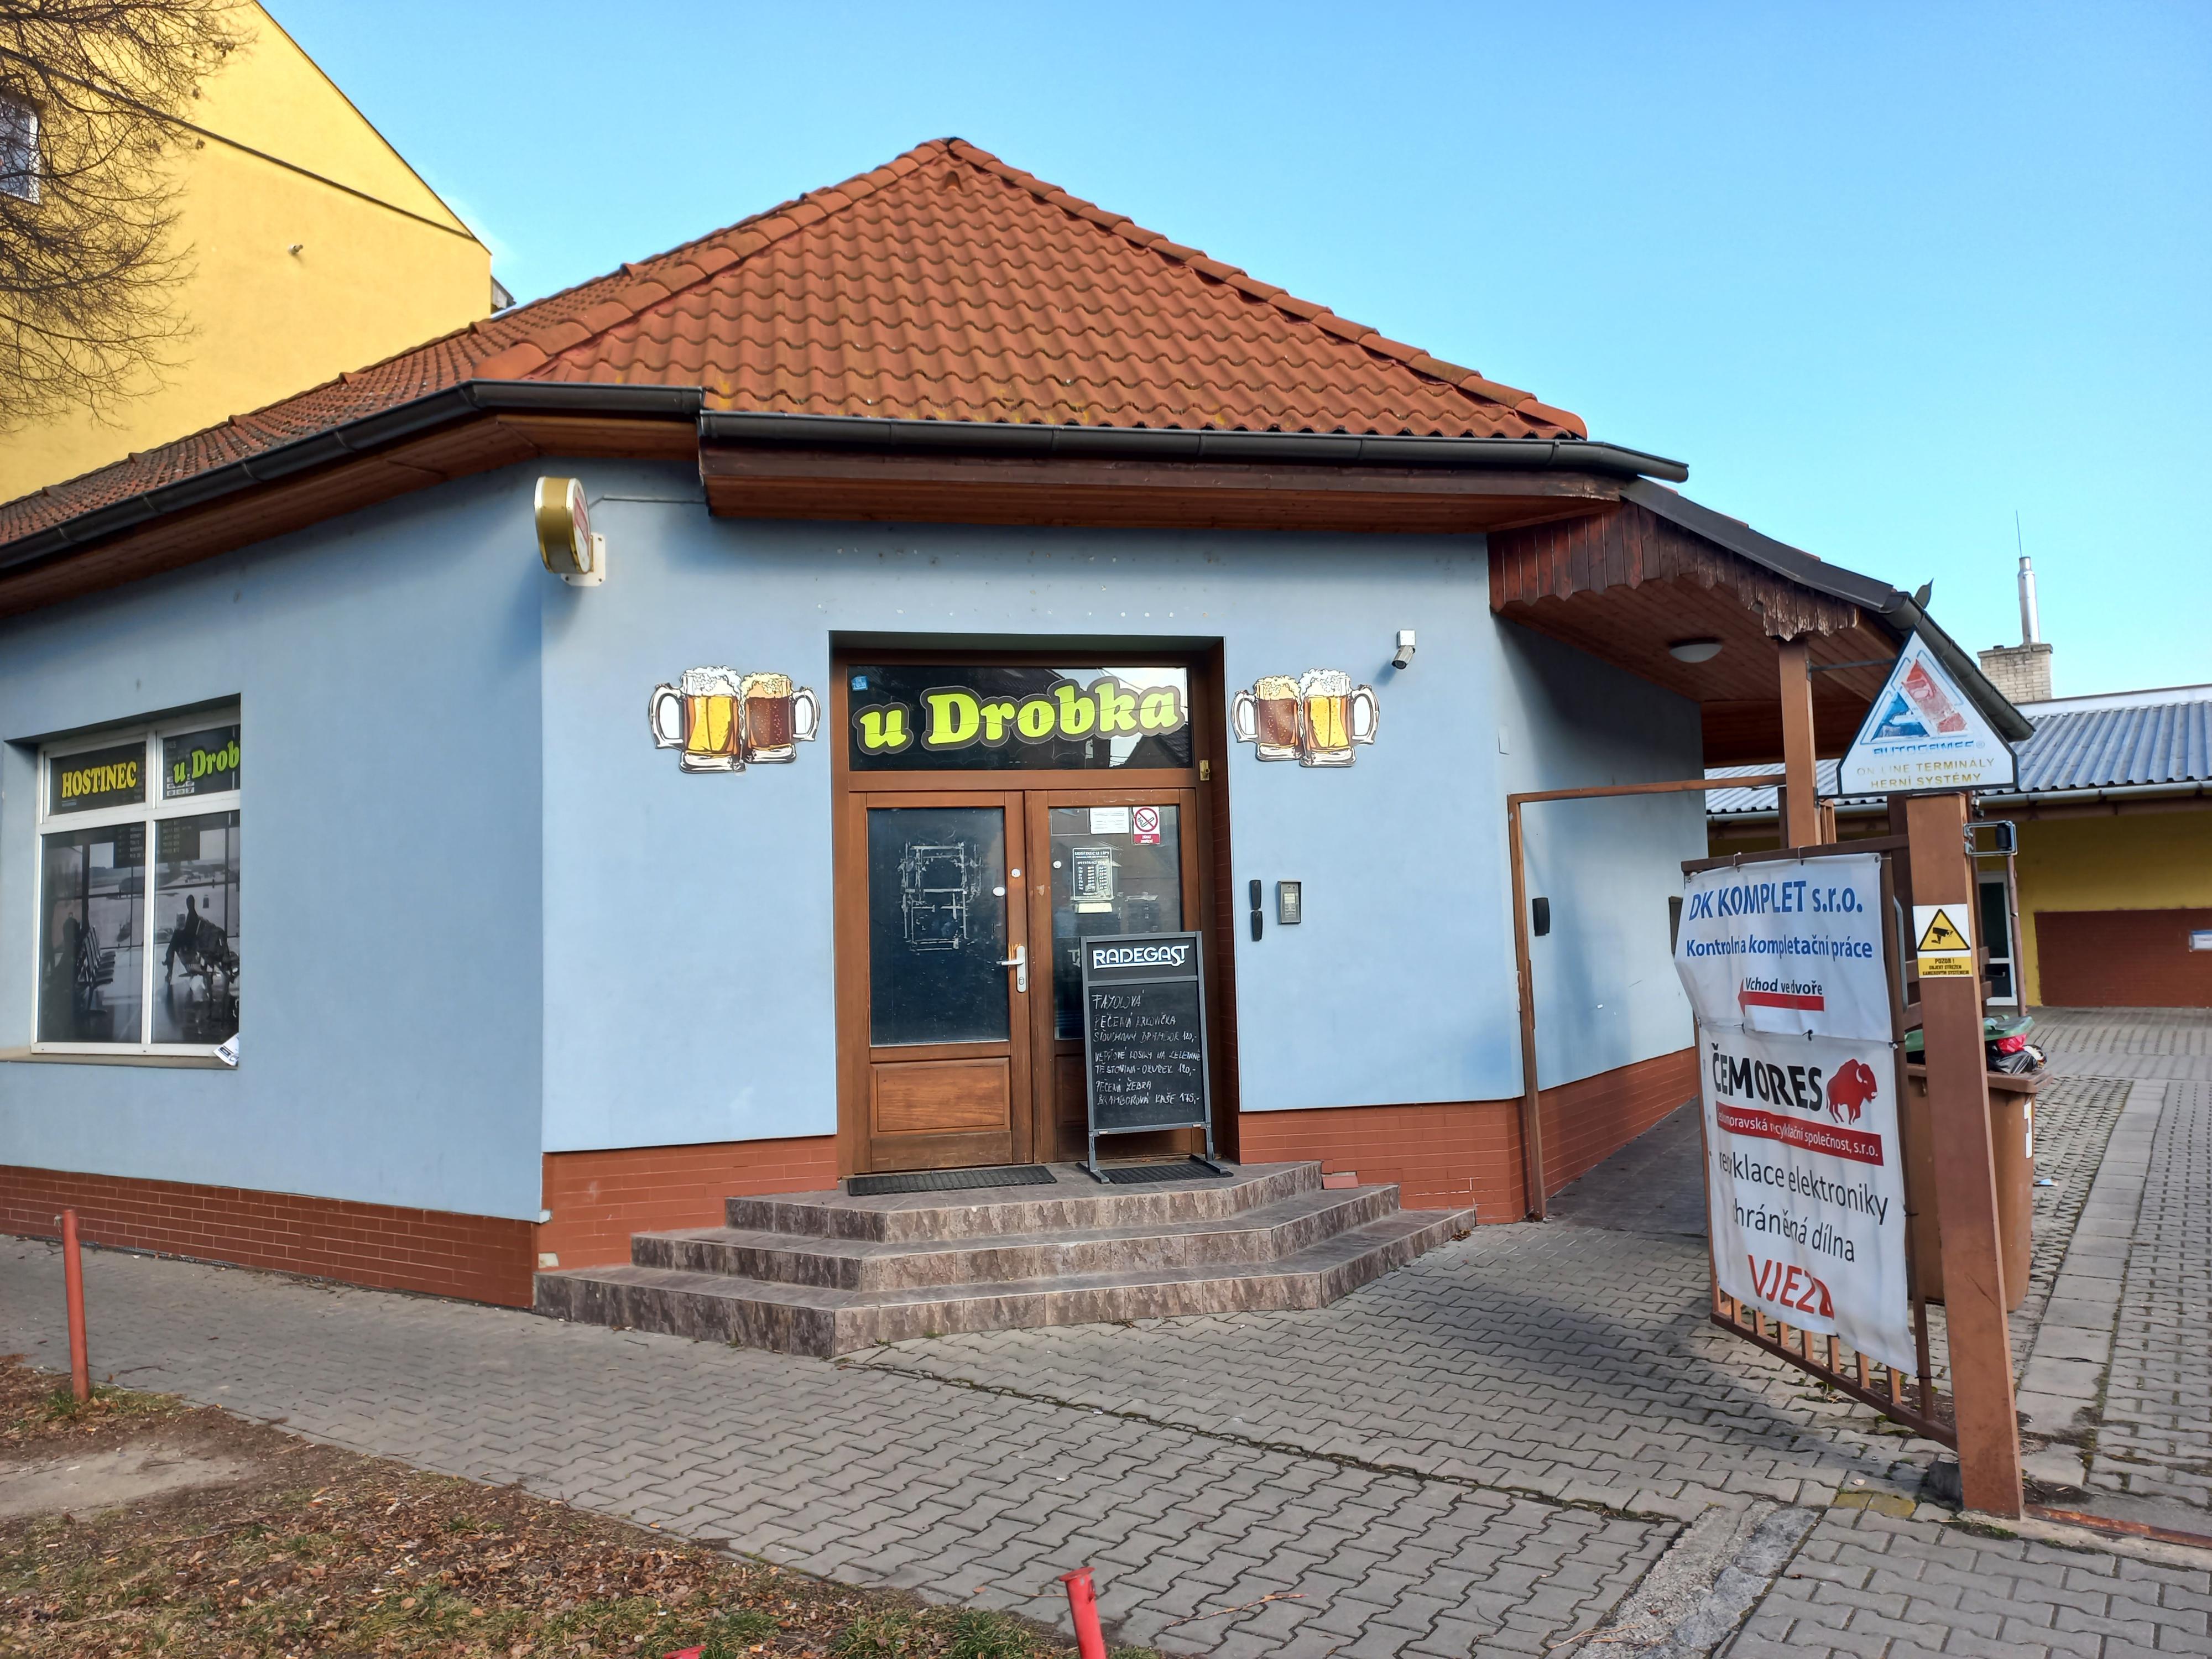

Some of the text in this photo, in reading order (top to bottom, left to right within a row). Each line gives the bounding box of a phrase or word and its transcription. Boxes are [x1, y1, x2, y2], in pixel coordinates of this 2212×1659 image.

[860, 682, 1178, 749] u Drobka
[61, 760, 137, 799] HOSTINEC
[173, 740, 240, 784] u Drob
[1871, 772, 1981, 789] HERNÍ SYSTÉMY
[1916, 757, 1995, 772] TERMINÁLY
[1688, 880, 1863, 921] DK KOMPLET s.r.o.
[1092, 945, 1190, 969] RADEGAST
[1748, 934, 1829, 959] kompletační
[1832, 936, 1872, 962] práce
[1745, 977, 1778, 992] Vchod
[1712, 1042, 1823, 1112] ČEMORES
[1804, 1130, 1852, 1154] společnost,
[1854, 1142, 1879, 1157] s.r.o.
[1788, 1165, 1888, 1225] elektroniky
[1733, 1198, 1855, 1262] hráněná dílna
